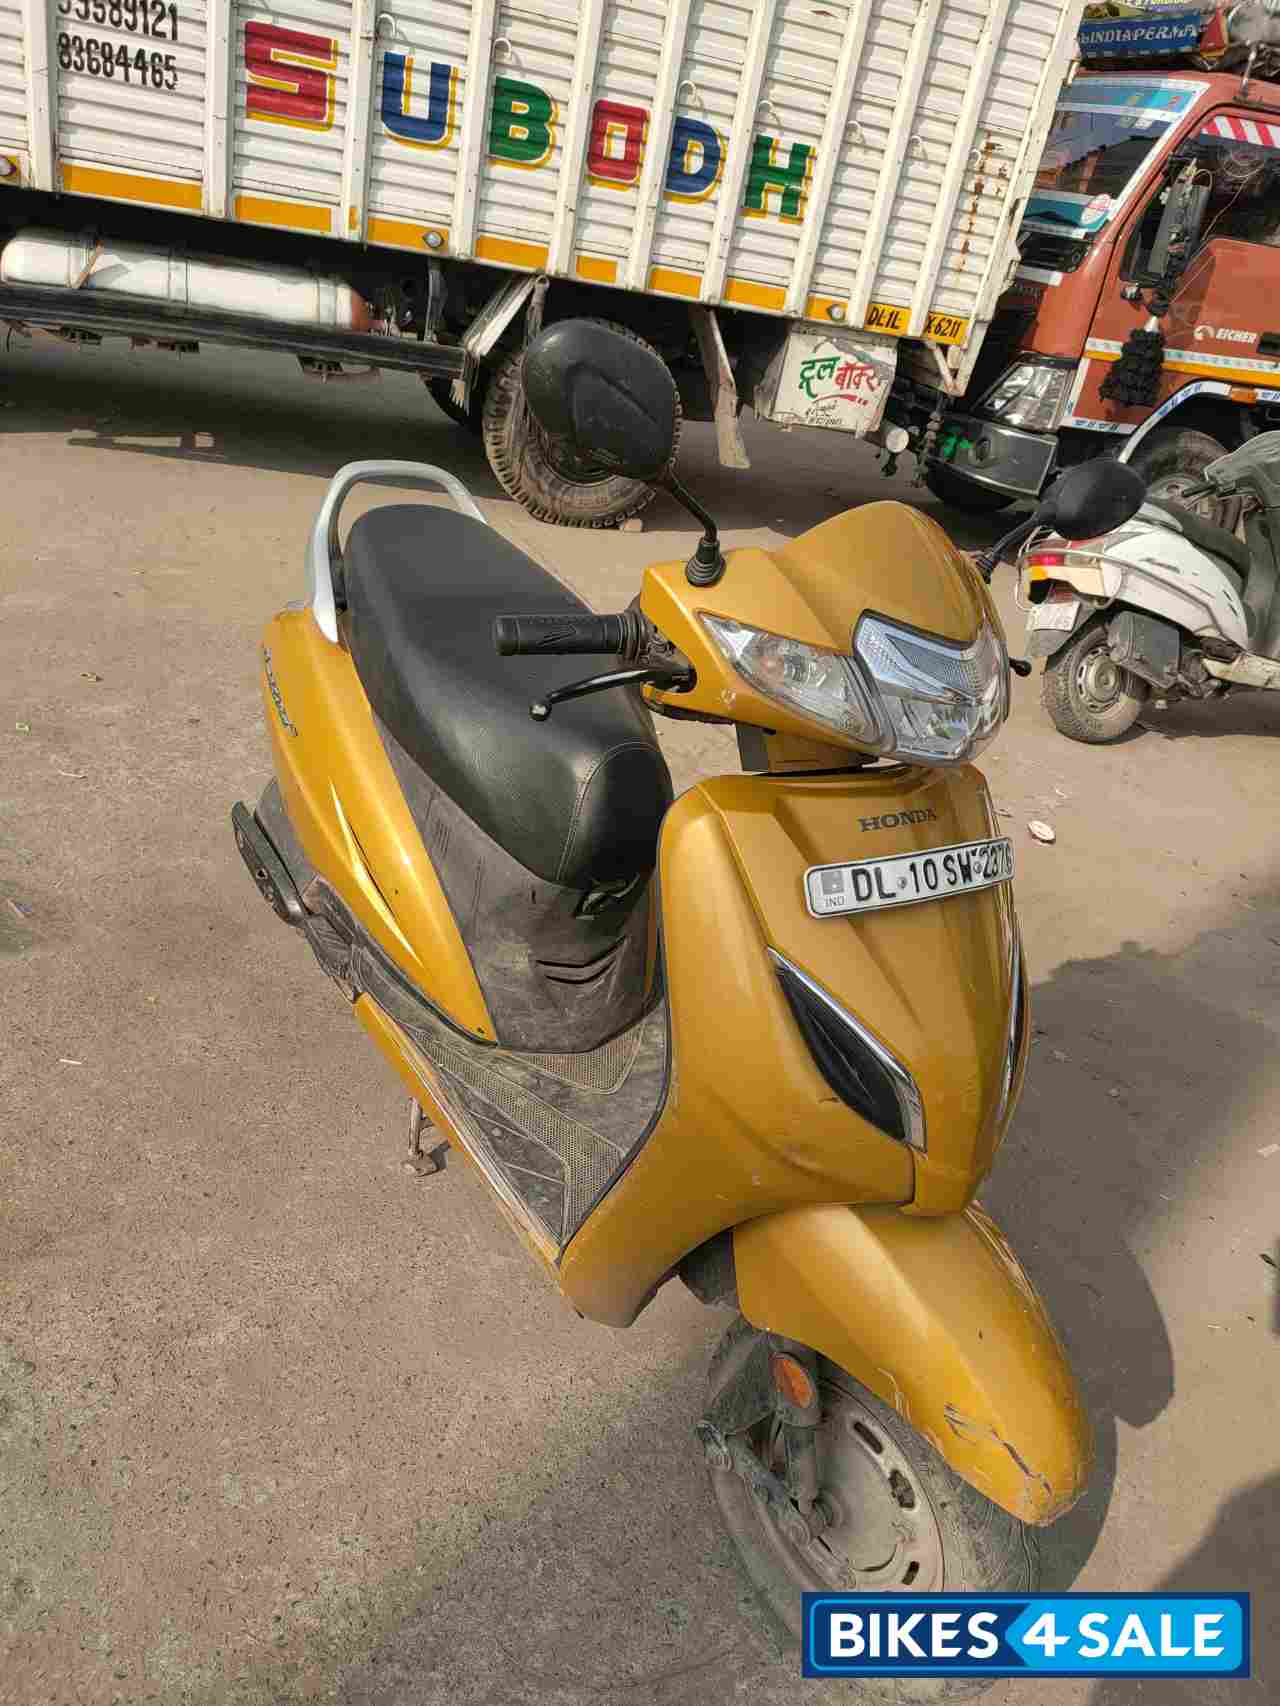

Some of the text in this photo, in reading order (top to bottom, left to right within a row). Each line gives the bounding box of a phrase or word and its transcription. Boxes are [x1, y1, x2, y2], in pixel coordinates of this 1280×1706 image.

[57, 32, 178, 90] 83684465
[857, 808, 937, 832] HONDA
[824, 895, 845, 907] IND
